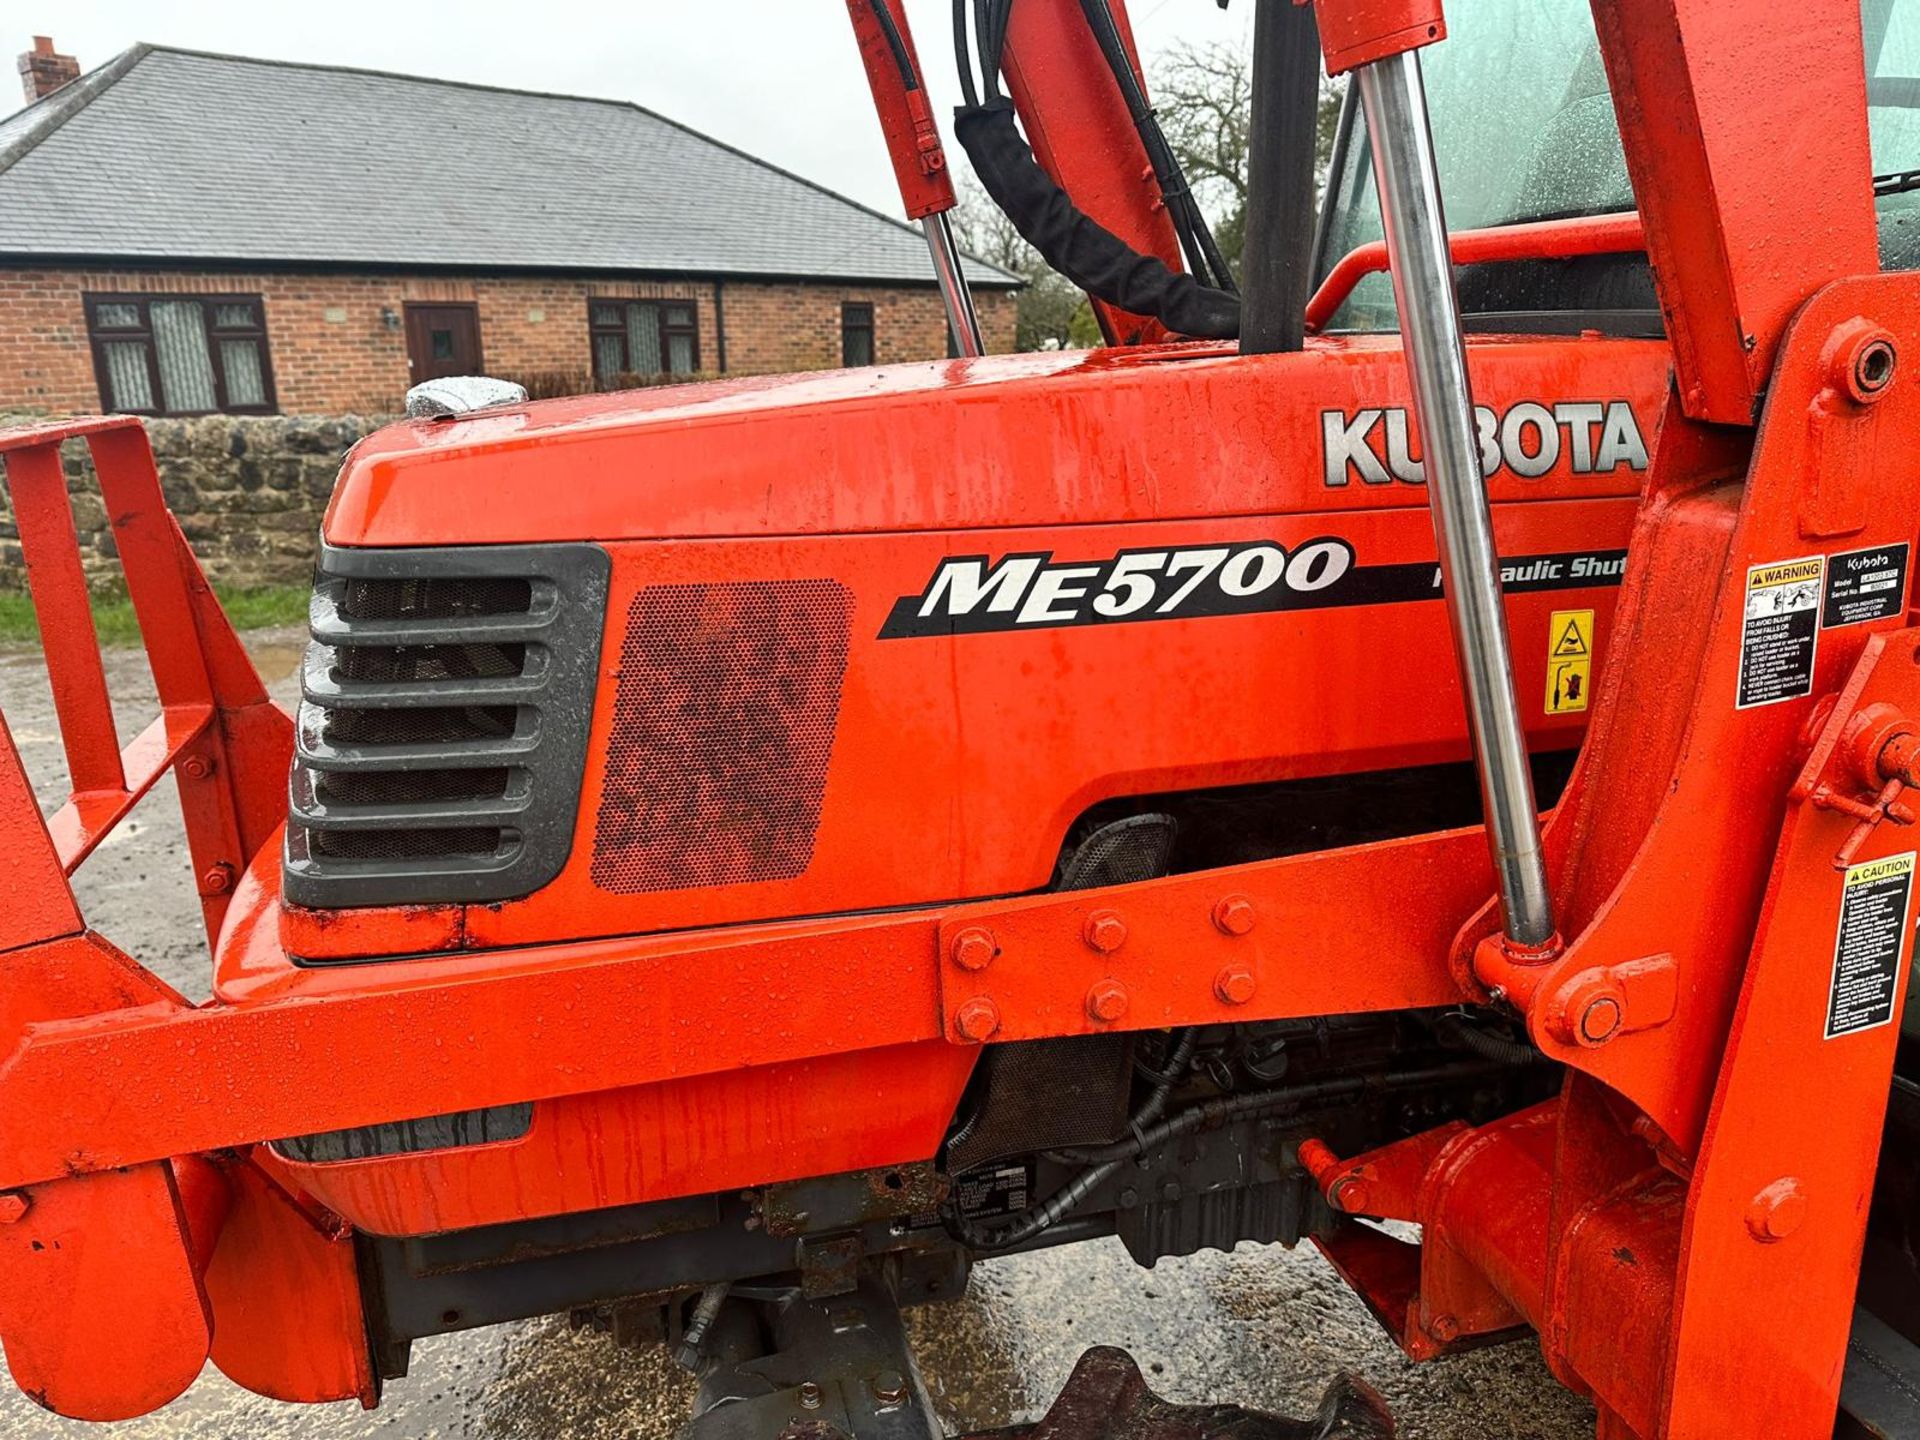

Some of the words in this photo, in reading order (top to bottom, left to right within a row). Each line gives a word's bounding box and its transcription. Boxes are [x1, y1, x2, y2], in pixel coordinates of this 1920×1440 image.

[1848, 554, 1888, 570] Kubota
[917, 541, 1350, 623] ME5700
[1765, 564, 1819, 583] WARNING
[1755, 618, 1771, 626] AVOID
[1773, 615, 1792, 623] INJURY
[1746, 628, 1762, 636] FROM
[1763, 625, 1779, 633] FALLS
[1862, 860, 1910, 878] CAUTION
